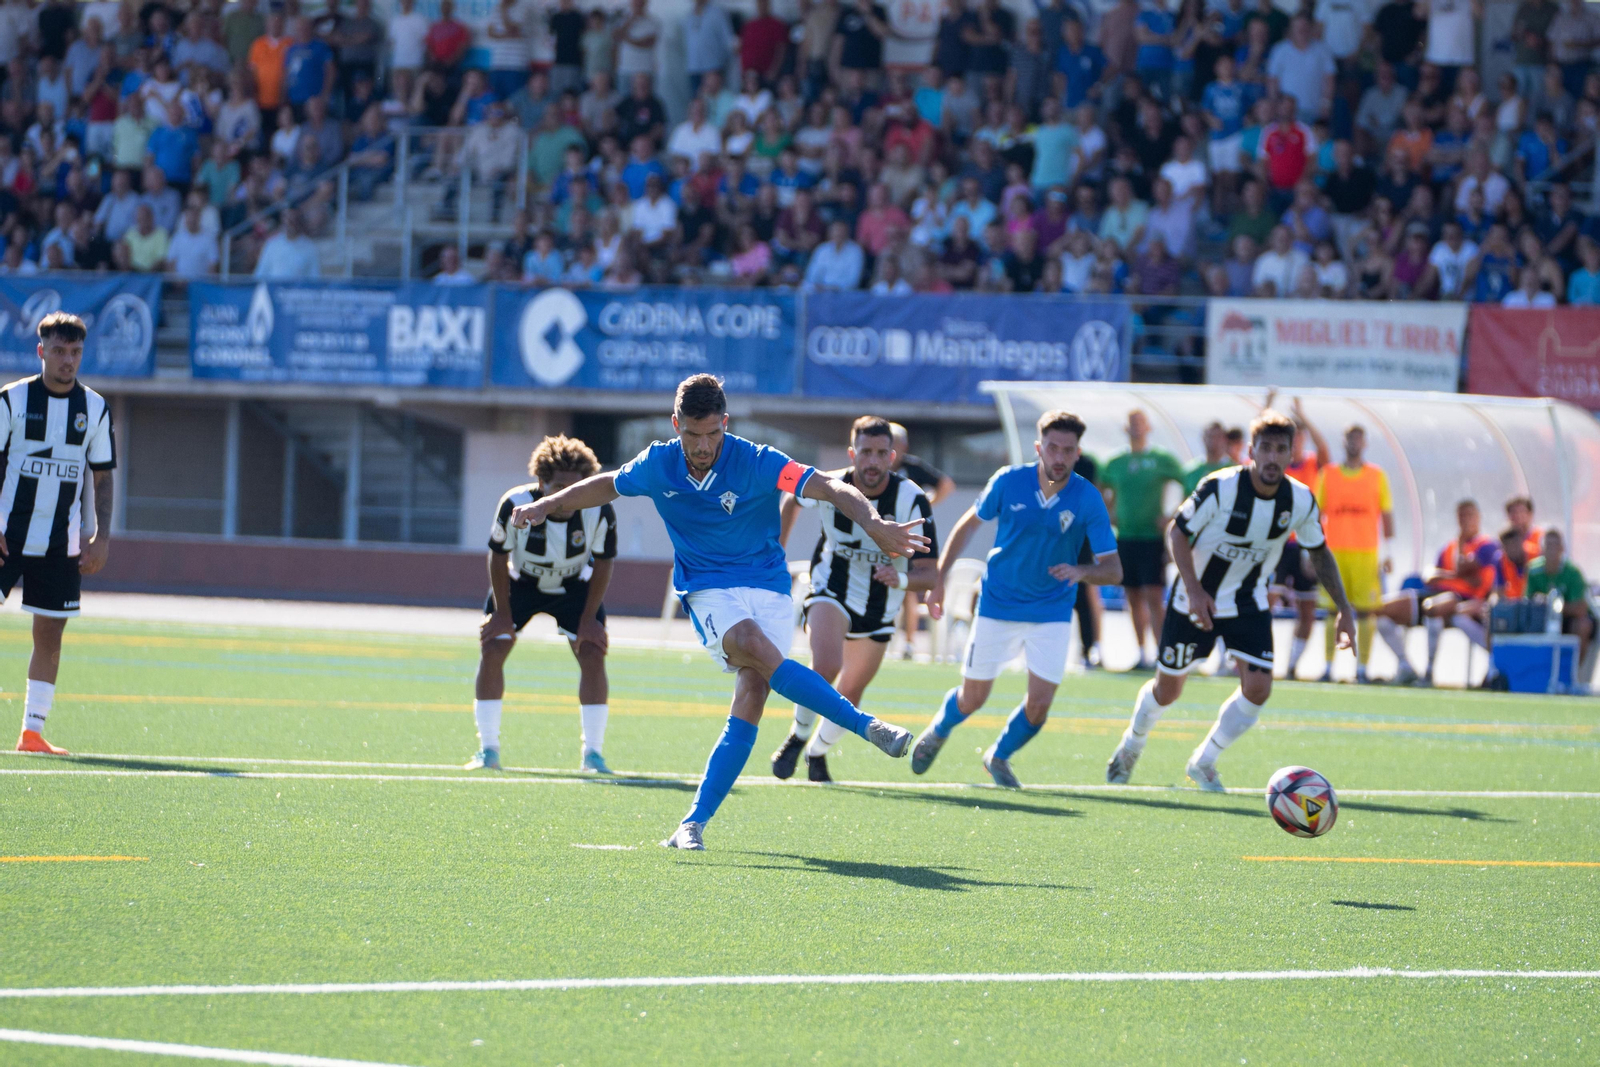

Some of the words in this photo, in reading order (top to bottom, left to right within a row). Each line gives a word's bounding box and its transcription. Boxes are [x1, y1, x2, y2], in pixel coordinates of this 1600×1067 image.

[388, 304, 486, 351] BAXI
[599, 302, 705, 336] CADENA
[706, 303, 782, 339] COPE
[1275, 316, 1460, 356] MIGUELTURRA
[915, 330, 1069, 376] Manchegos
[21, 458, 81, 480] LOTUS
[522, 561, 582, 578] LOTUS
